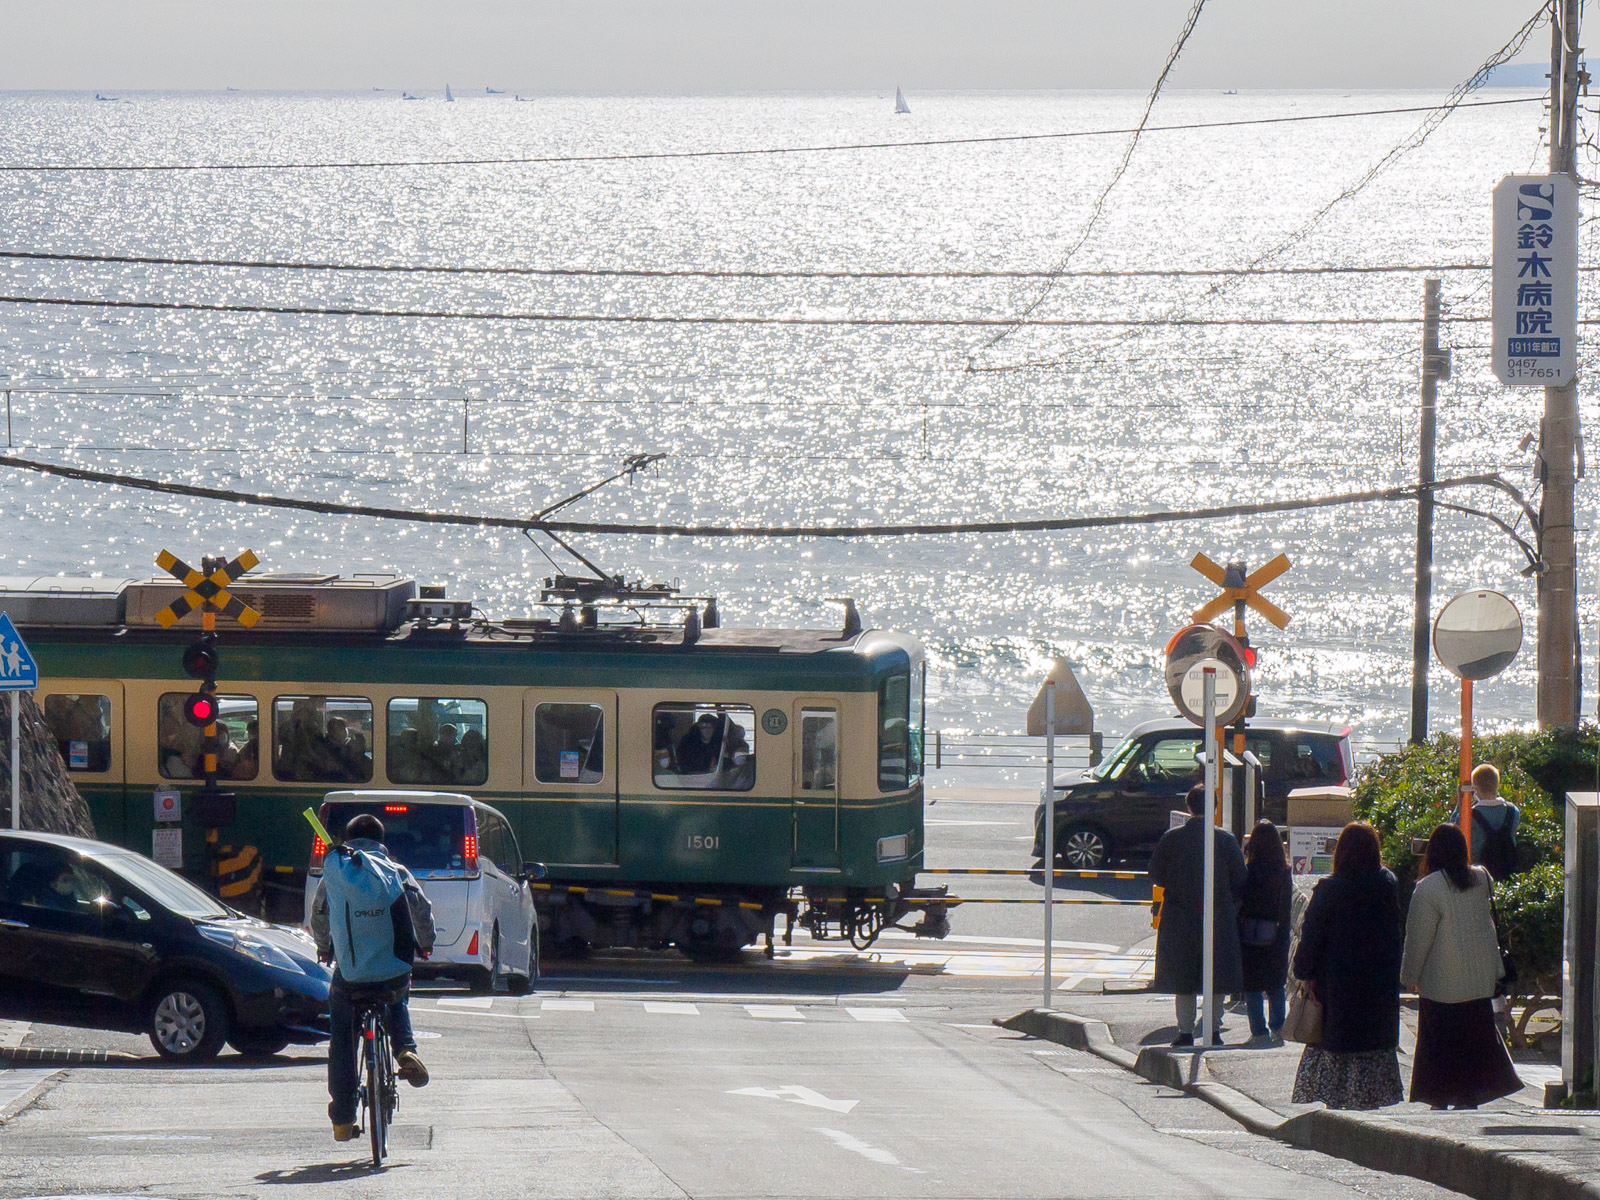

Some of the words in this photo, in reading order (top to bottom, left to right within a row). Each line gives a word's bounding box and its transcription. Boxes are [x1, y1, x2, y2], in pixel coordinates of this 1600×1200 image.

[1516, 223, 1553, 335] 鈴木病院
[1508, 358, 1538, 368] 0467
[1507, 368, 1560, 378] 31-7651
[687, 835, 720, 849] 1501
[354, 907, 386, 918] OAKLEY
